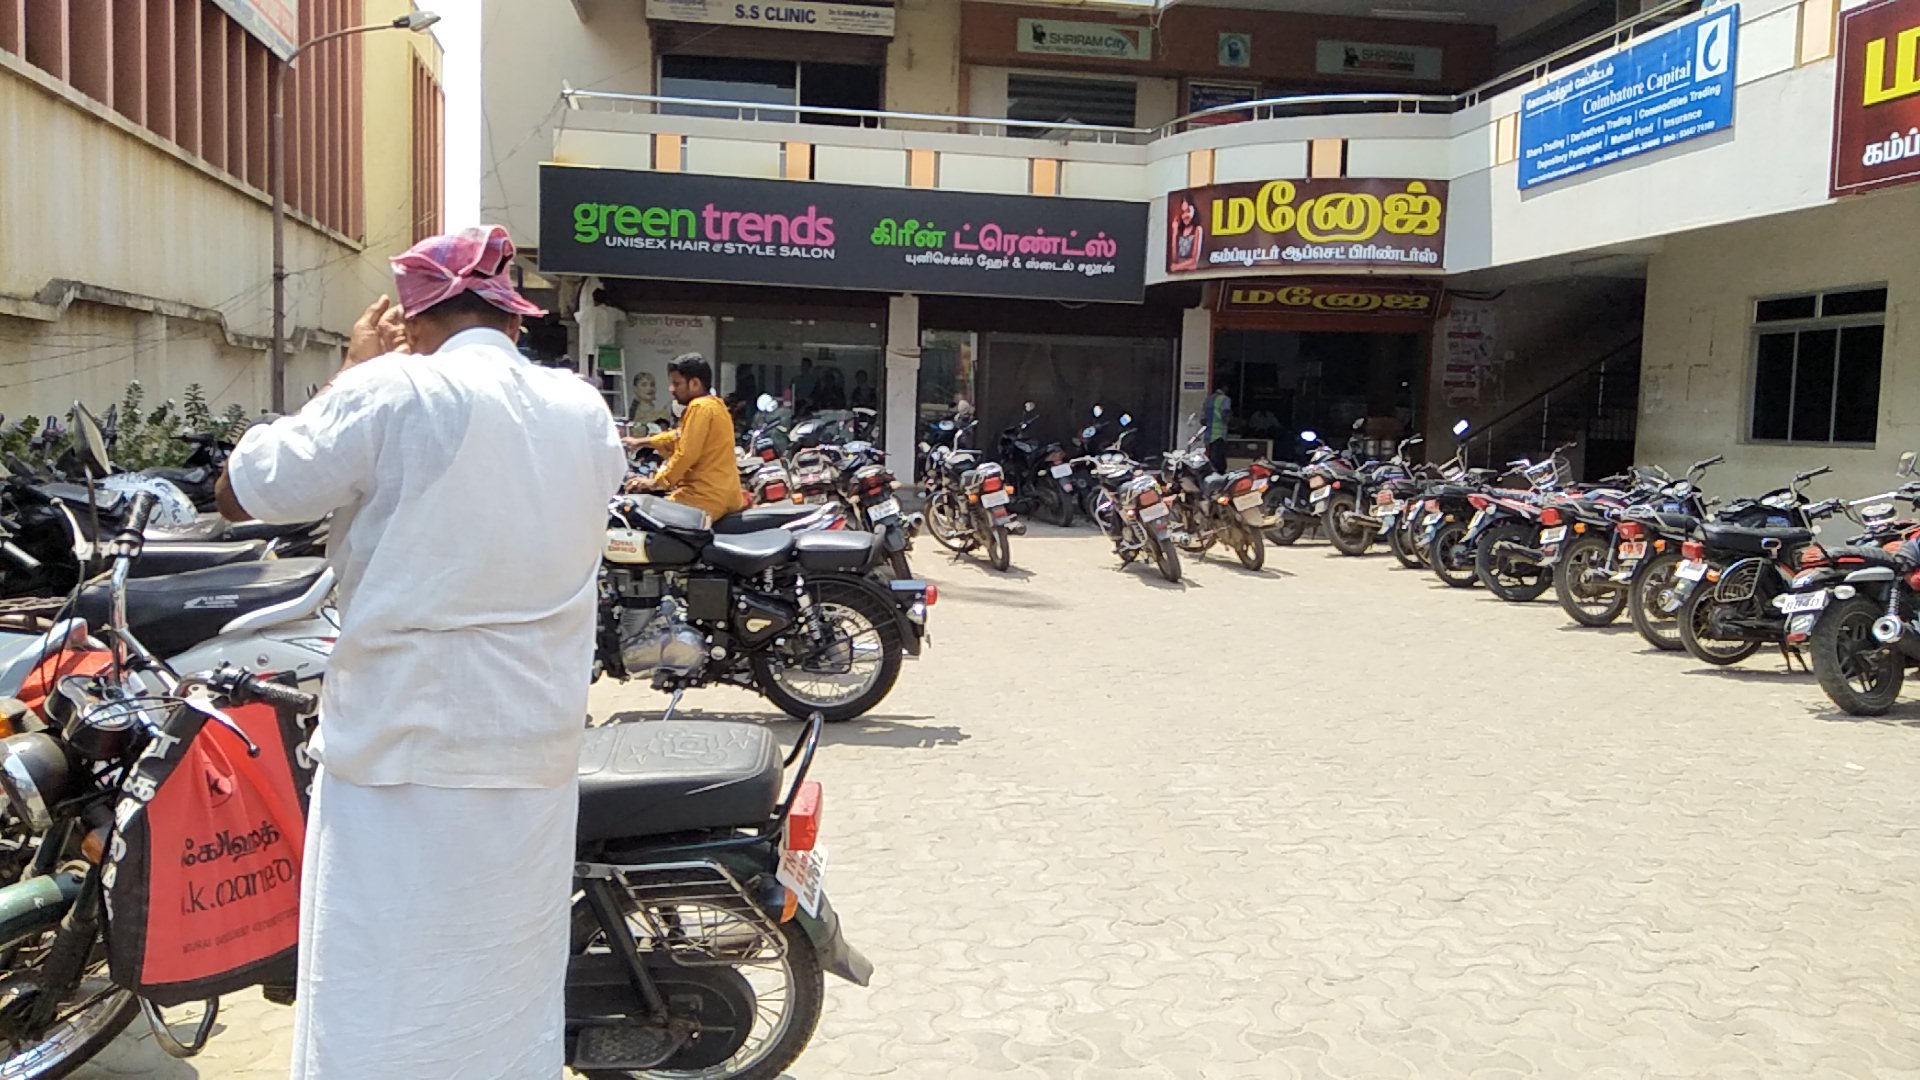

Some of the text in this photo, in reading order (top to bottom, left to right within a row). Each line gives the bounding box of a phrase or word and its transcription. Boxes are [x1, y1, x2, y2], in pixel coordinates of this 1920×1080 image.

[735, 4, 760, 20] S.S
[764, 6, 817, 24] CLINIC
[1050, 32, 1129, 50] SHRIRAM City
[1583, 60, 1691, 114] Coimbatore Capital
[1606, 115, 1632, 130] Trading
[1639, 95, 1688, 118] Commodities
[1690, 84, 1721, 102] Trading
[1663, 109, 1702, 129] Insurance
[574, 202, 836, 247] green trends
[605, 235, 667, 250] UNISEX
[670, 239, 710, 252] HAIR
[724, 243, 777, 256] STYLE
[779, 245, 836, 260] SALON
[870, 218, 1118, 258] கிரீன் ட்ரெண்ட்ஸ்
[905, 251, 974, 267] யுனிசெக்ஸ்
[977, 253, 1009, 271] ஹேர்
[1025, 257, 1075, 272] ஸ்டைல்
[1281, 244, 1346, 261] ஆப்செட்
[1349, 243, 1438, 264] பிரிண்டர்ஸ்
[628, 315, 704, 328] green trends
